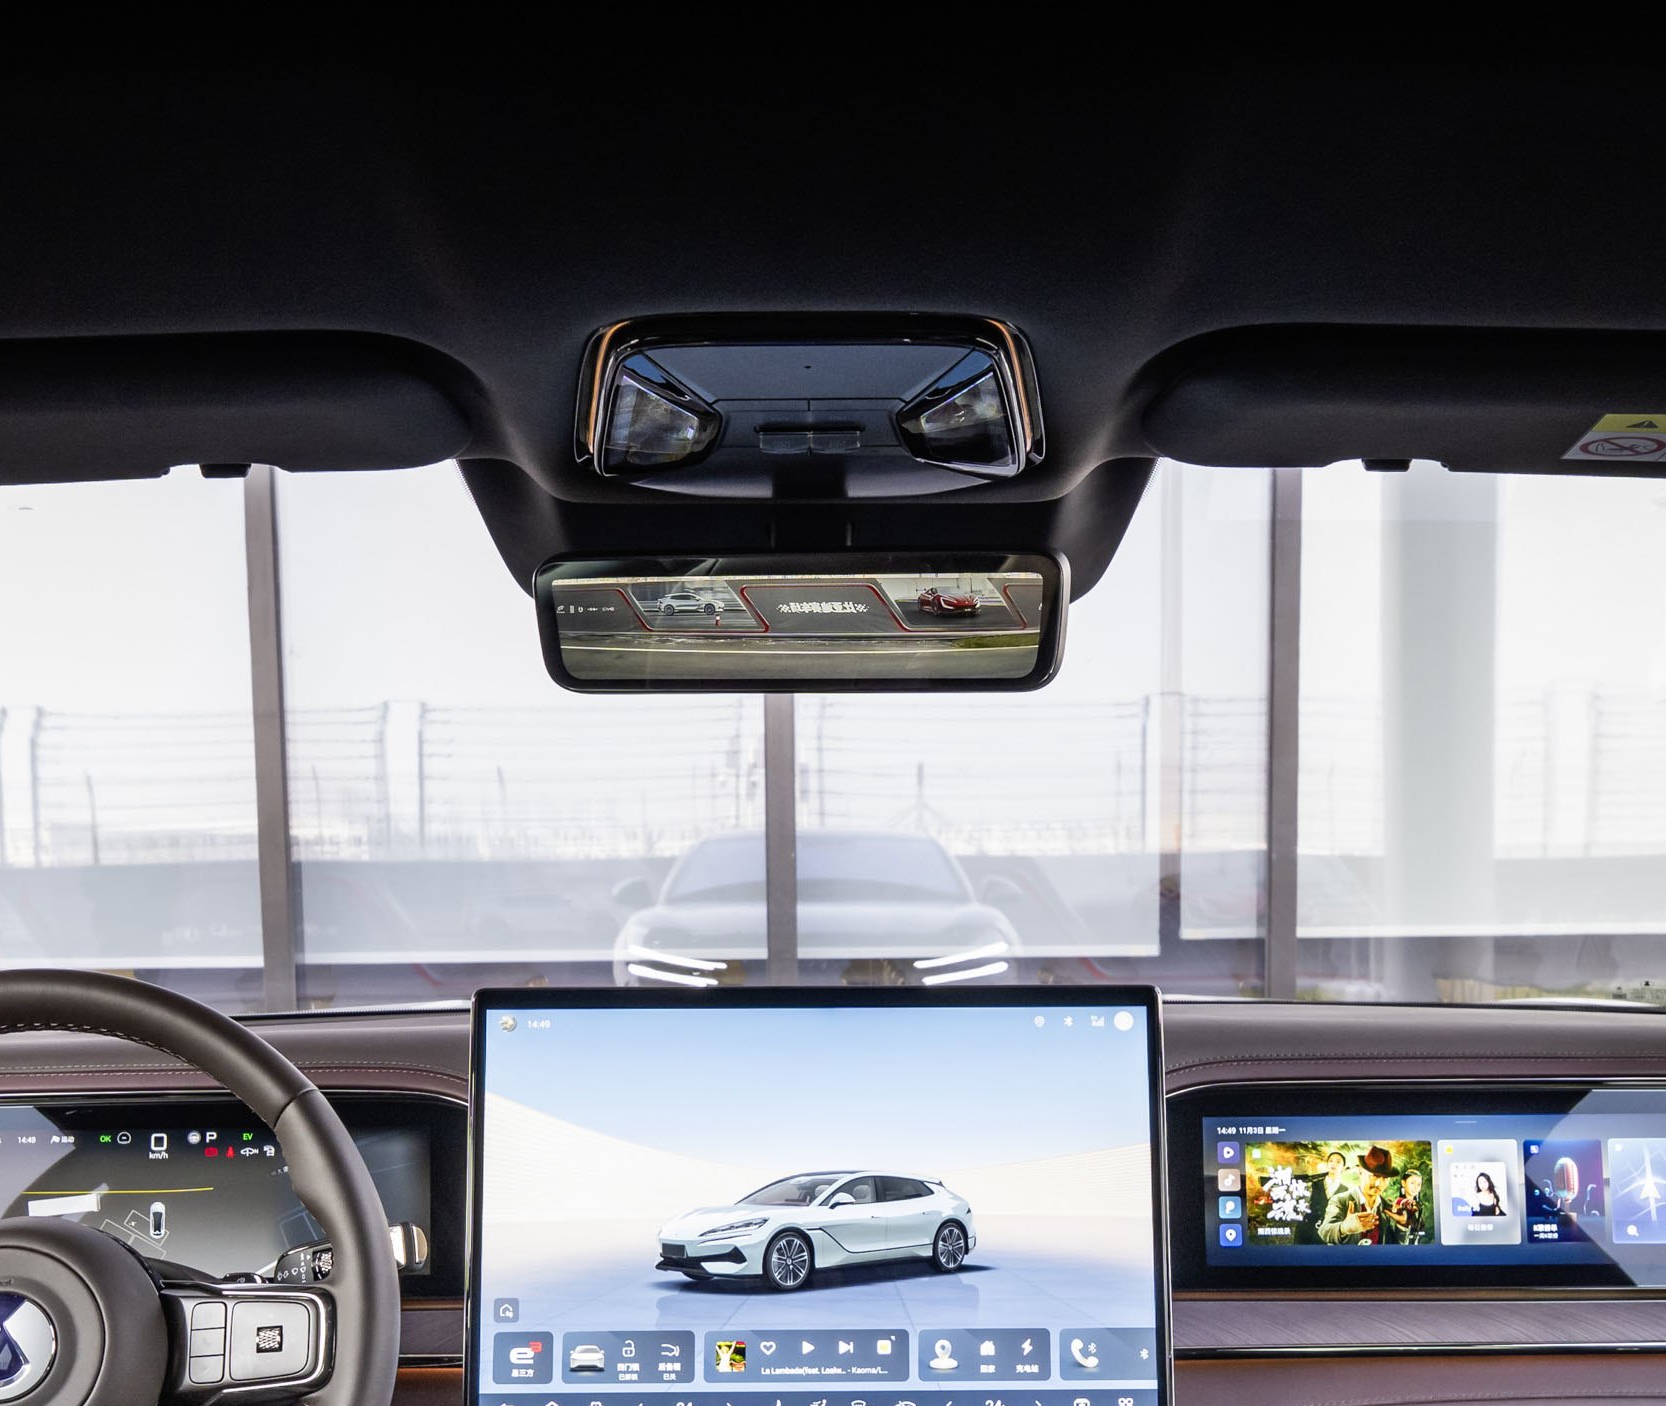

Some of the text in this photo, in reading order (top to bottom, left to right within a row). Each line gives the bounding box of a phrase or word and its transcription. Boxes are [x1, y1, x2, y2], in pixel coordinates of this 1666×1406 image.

[1216, 1126, 1237, 1135] 14:49
[1239, 1126, 1264, 1135] 11月3日
[17, 1136, 37, 1144] 14:49
[99, 1134, 112, 1143] OK
[206, 1132, 218, 1143] P
[242, 1132, 254, 1141] EV
[149, 1151, 169, 1160] km/h
[1015, 1364, 1039, 1374] 充电站
